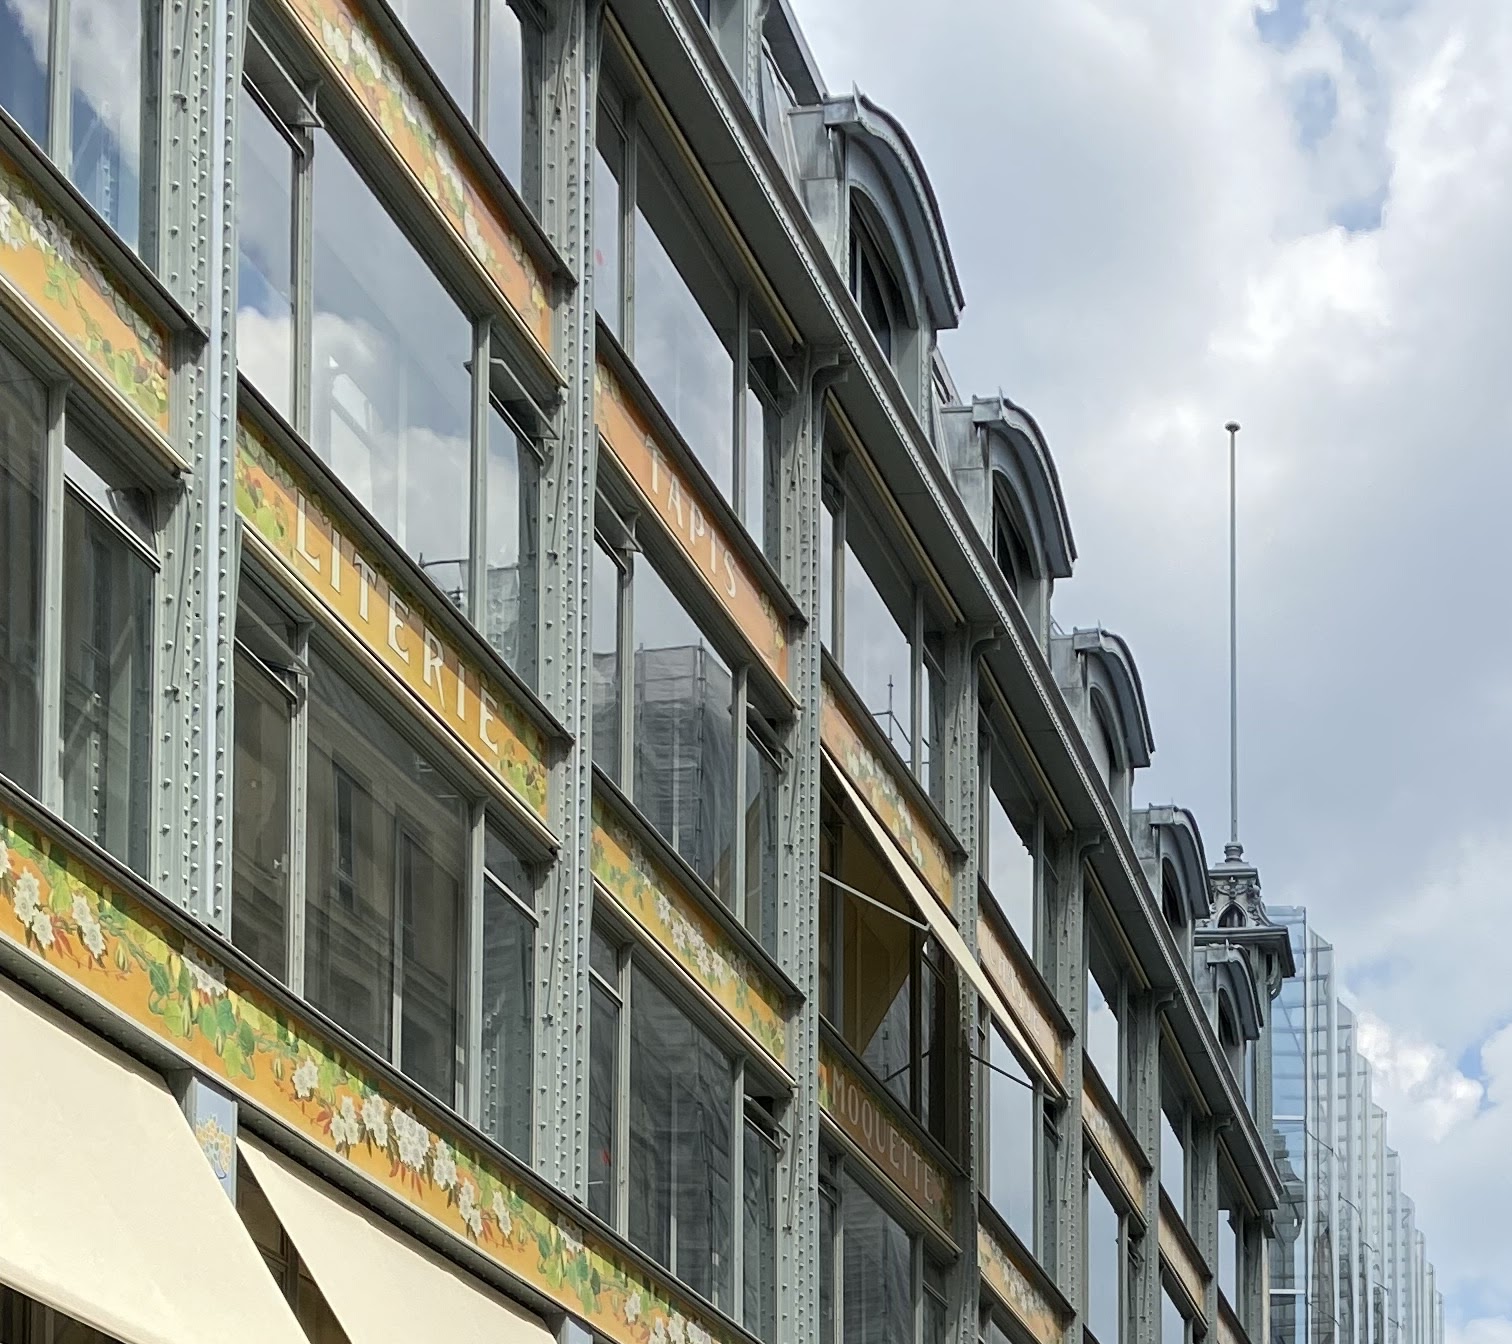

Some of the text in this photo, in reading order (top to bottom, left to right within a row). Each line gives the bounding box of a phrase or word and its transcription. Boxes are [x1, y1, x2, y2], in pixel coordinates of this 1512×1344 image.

[645, 434, 736, 598] TAPIS
[295, 488, 499, 755] LITERIE
[832, 1064, 934, 1205] MOQUETTE
